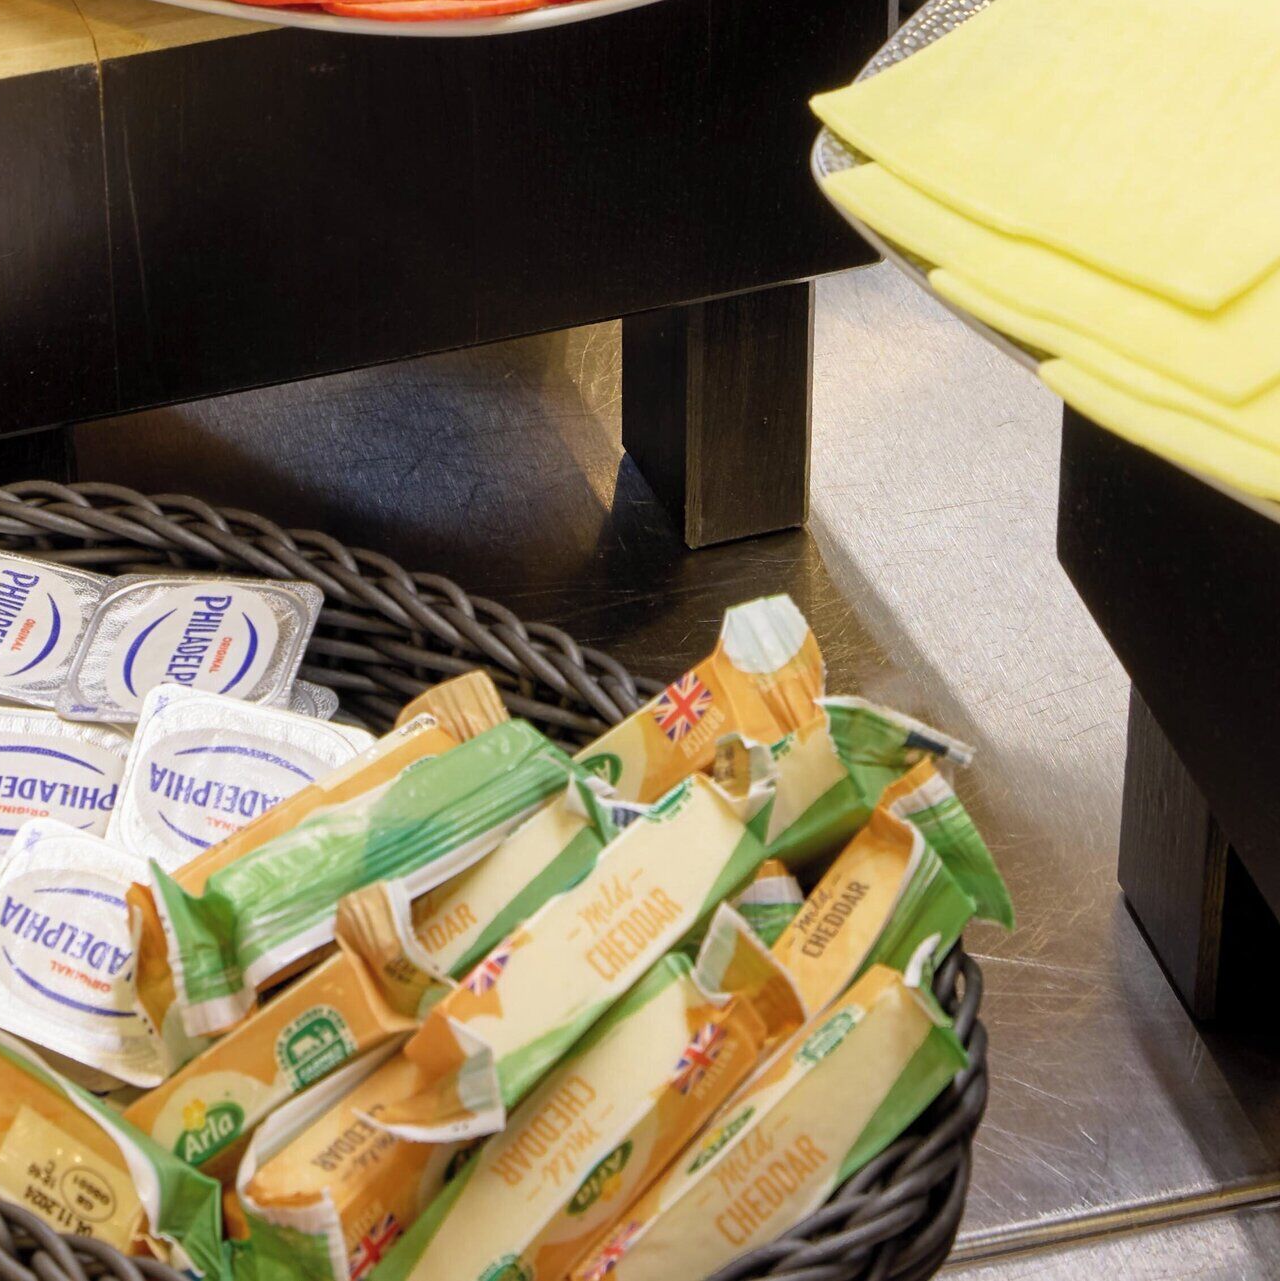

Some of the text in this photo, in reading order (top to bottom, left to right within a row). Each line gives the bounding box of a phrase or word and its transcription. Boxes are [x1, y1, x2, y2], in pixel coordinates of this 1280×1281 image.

[10, 617, 37, 653] ORIGINAL
[159, 595, 233, 689] PHILADELP
[208, 636, 233, 674] ORIGINAL
[578, 871, 634, 937] mild
[585, 885, 686, 983] CHEDDAR
[796, 886, 835, 937] mild
[800, 879, 871, 961] CHEDDAR
[49, 959, 113, 994] ORIGINAL
[183, 1111, 236, 1164] Arla
[493, 1074, 597, 1186] CHEDDAR
[539, 1118, 604, 1188] mild
[714, 1128, 781, 1198] mild
[712, 1133, 829, 1249] CHEDDAR
